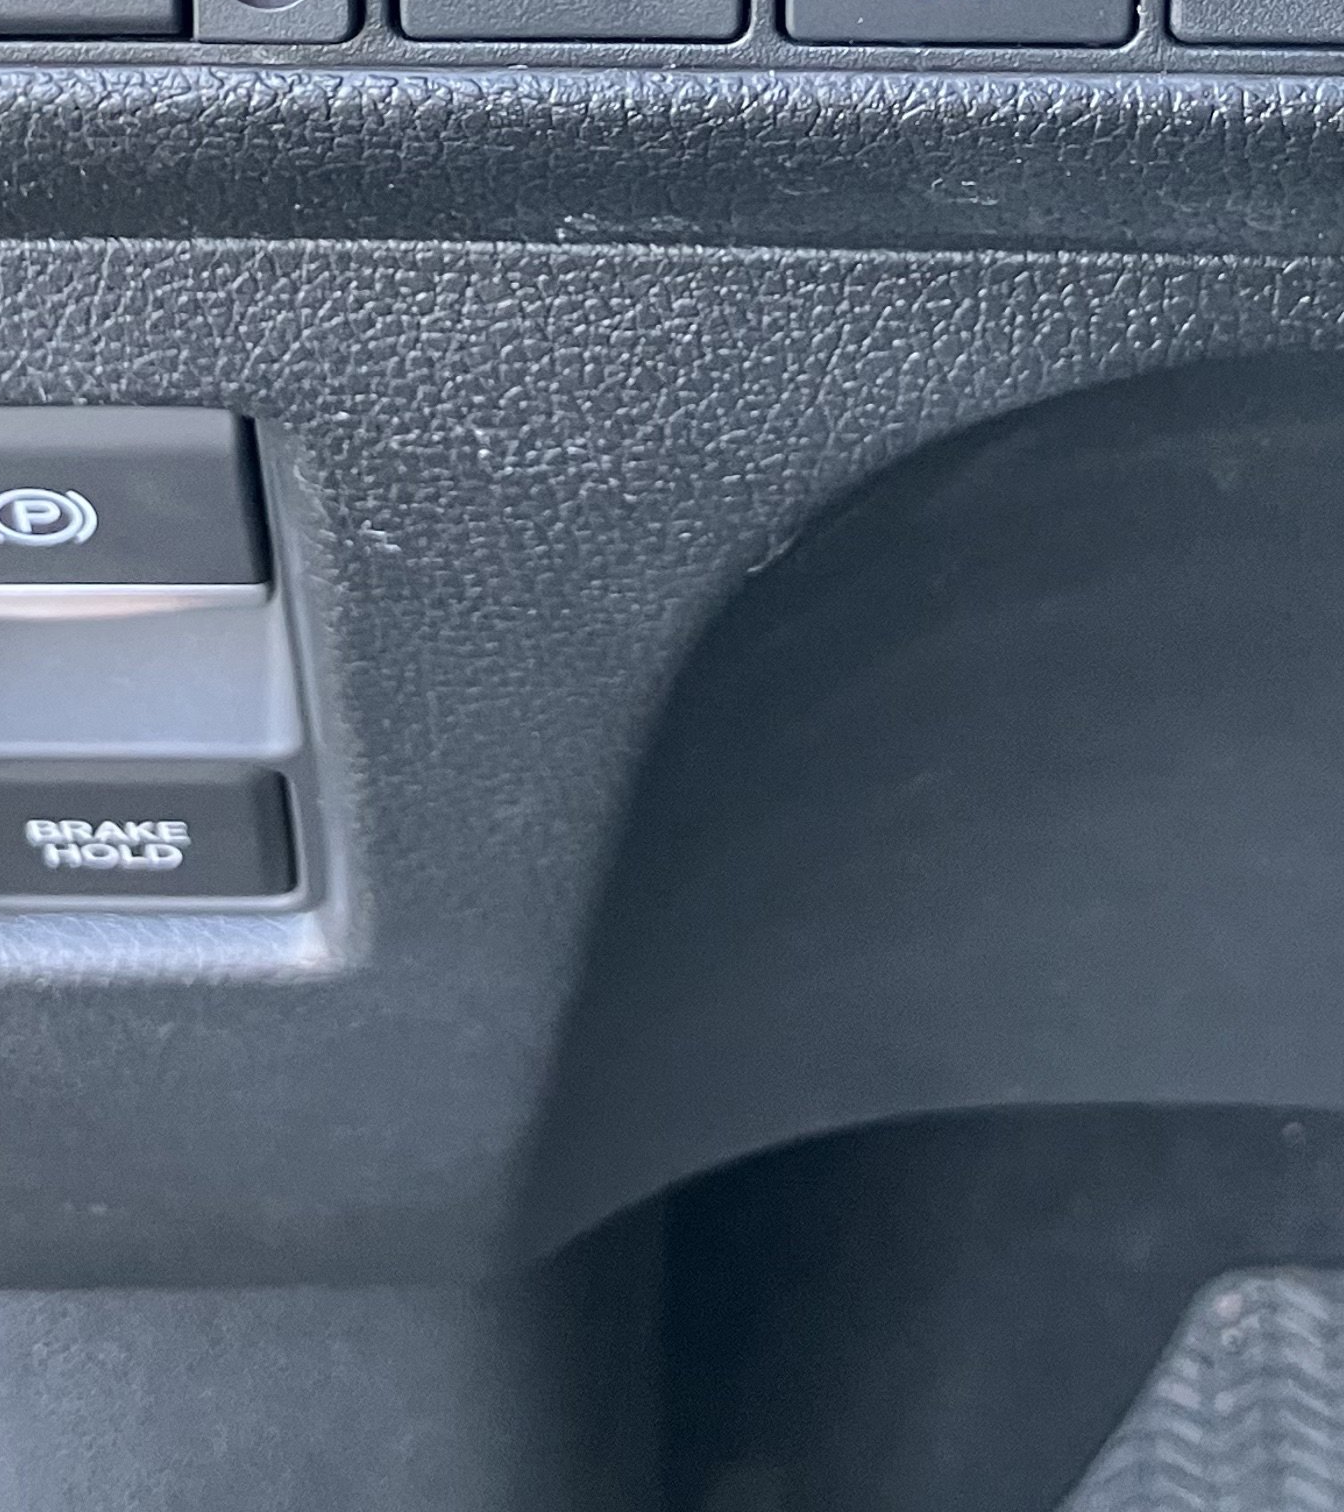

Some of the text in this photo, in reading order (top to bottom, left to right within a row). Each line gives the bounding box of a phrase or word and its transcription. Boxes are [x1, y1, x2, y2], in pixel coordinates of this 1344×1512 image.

[11, 499, 62, 533] P
[25, 819, 191, 845] BRAKE
[43, 844, 183, 870] HOLD
